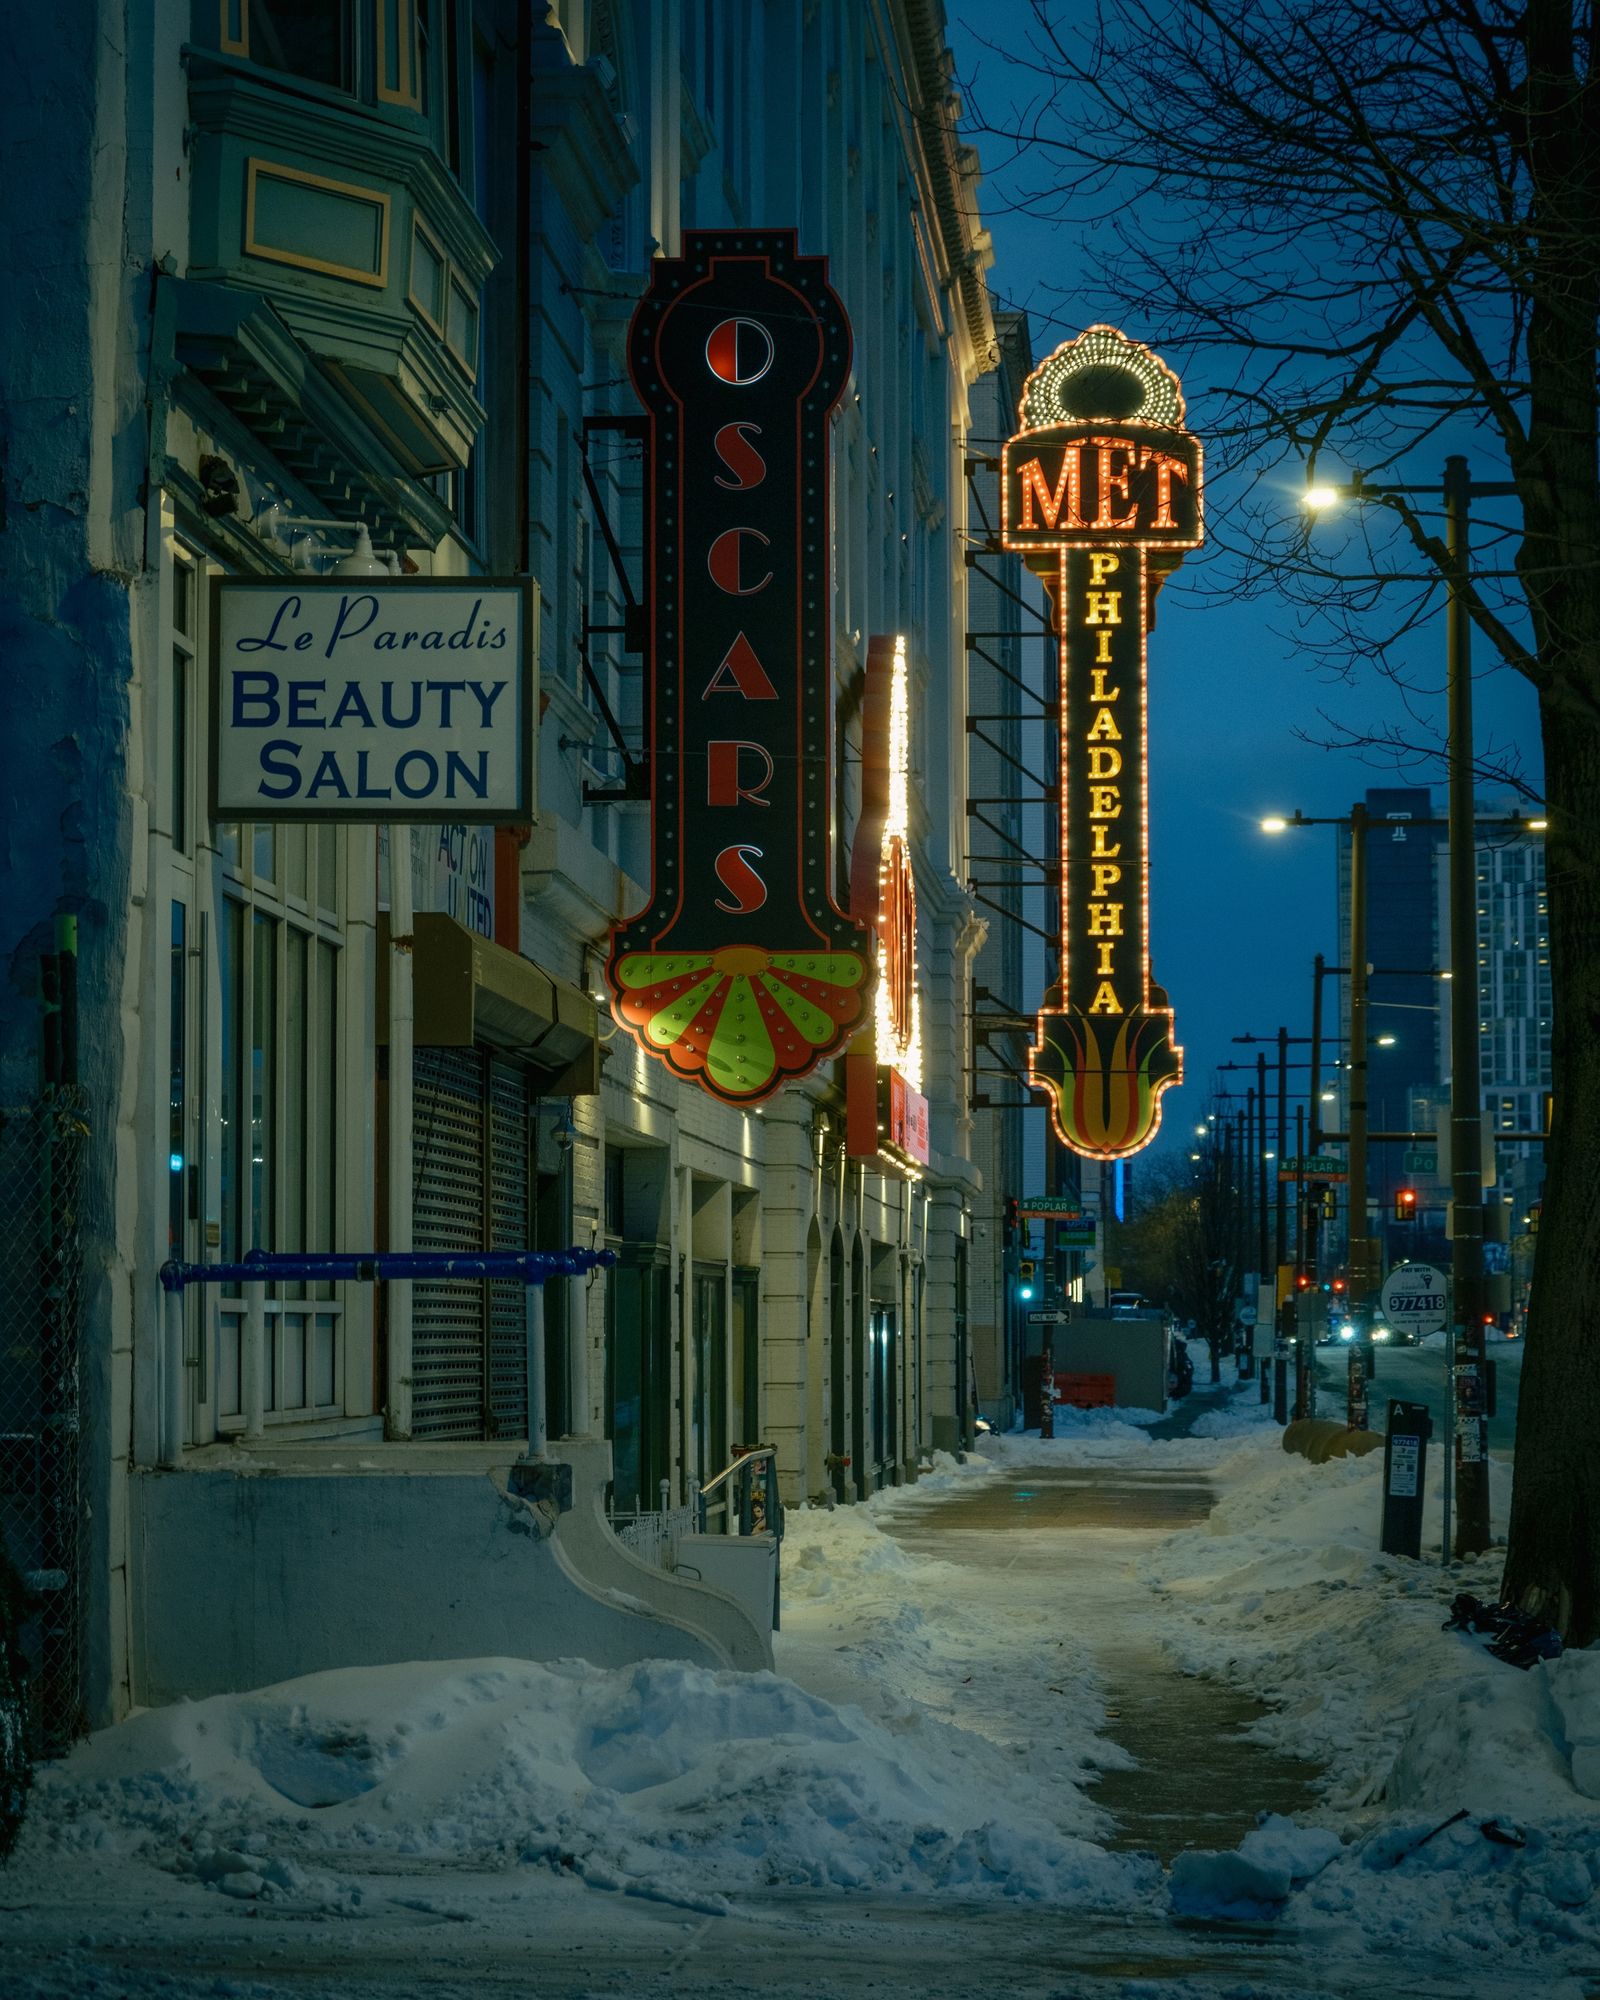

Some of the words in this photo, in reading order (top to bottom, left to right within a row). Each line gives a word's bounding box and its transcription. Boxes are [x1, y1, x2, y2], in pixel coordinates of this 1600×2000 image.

[1016, 436, 1189, 530] MET
[236, 596, 313, 652] Le
[324, 595, 507, 658] Paradis
[701, 316, 779, 915] OSCARS
[231, 671, 508, 729] BEAUTY
[257, 739, 490, 800] SALON
[1085, 552, 1124, 1014] PHILADELPHIA
[1291, 1161, 1333, 1173] PPLAR
[1031, 1201, 1067, 1212] POPLAR
[1390, 1295, 1445, 1311] 977418
